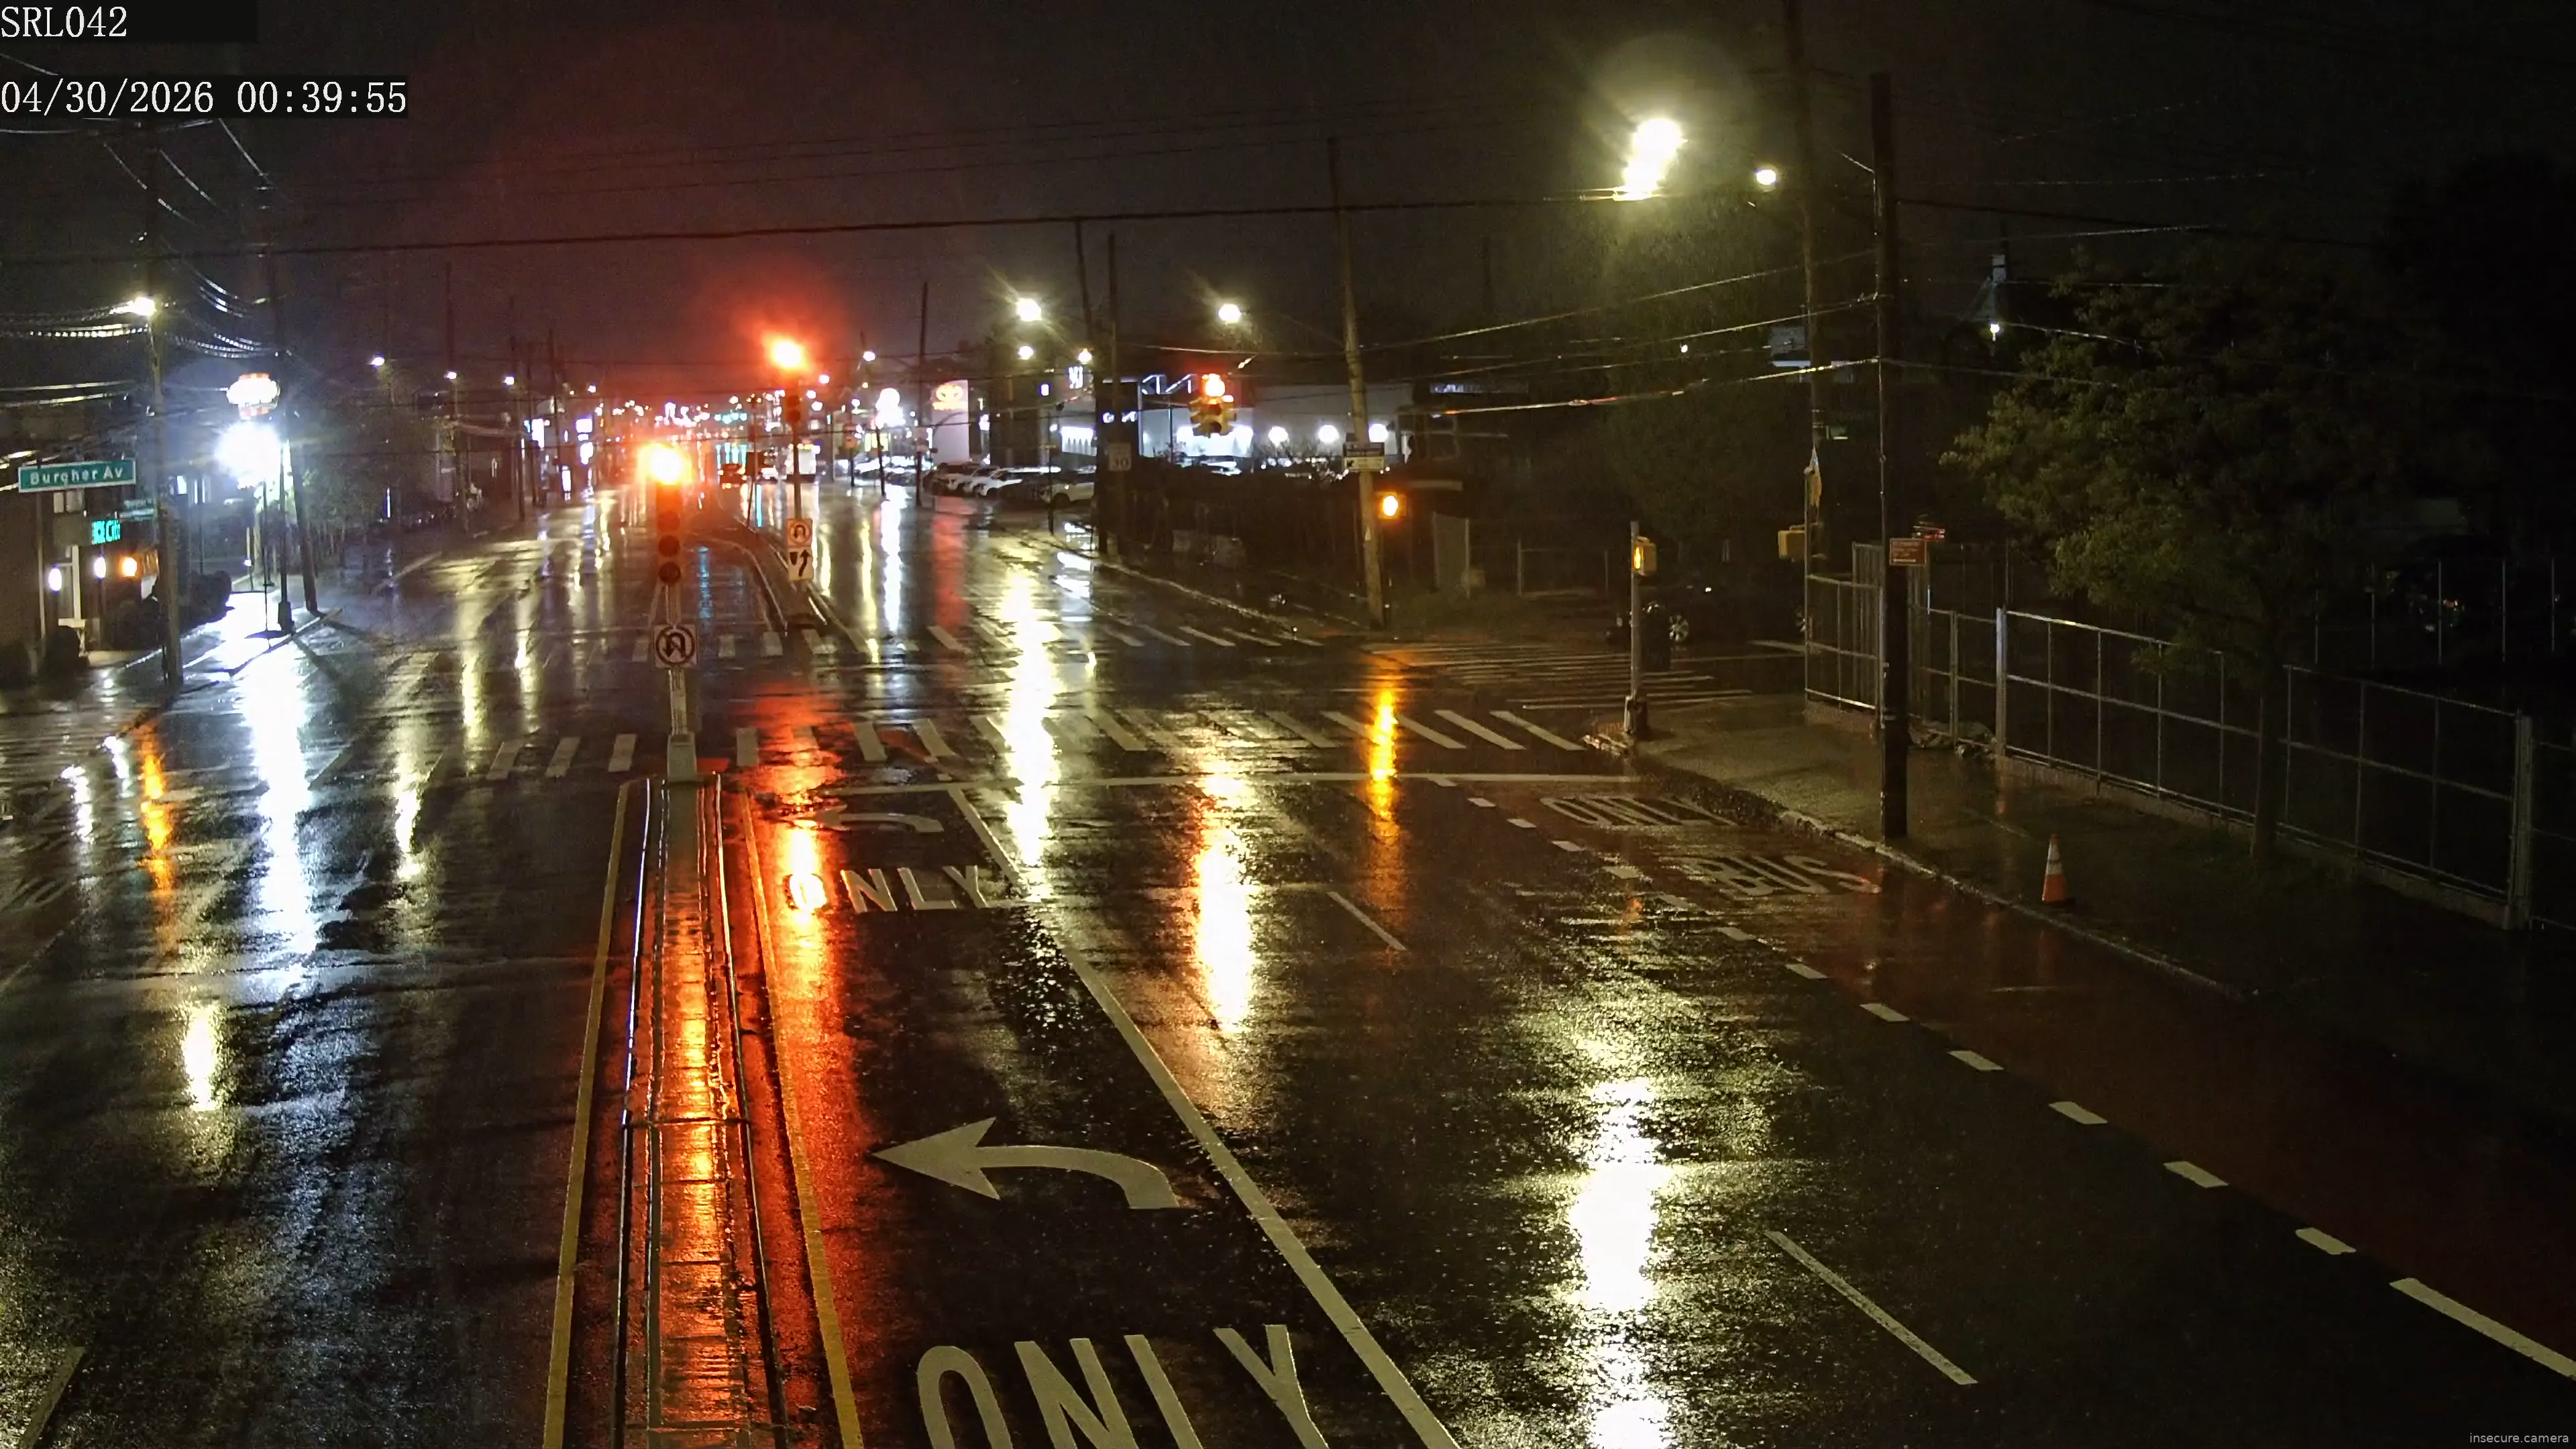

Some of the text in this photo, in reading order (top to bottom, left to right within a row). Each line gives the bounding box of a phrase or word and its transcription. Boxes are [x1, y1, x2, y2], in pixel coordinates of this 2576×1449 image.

[30, 466, 123, 486] Burgher Av
[788, 865, 989, 913] ONLY
[1660, 855, 1882, 900] BUS
